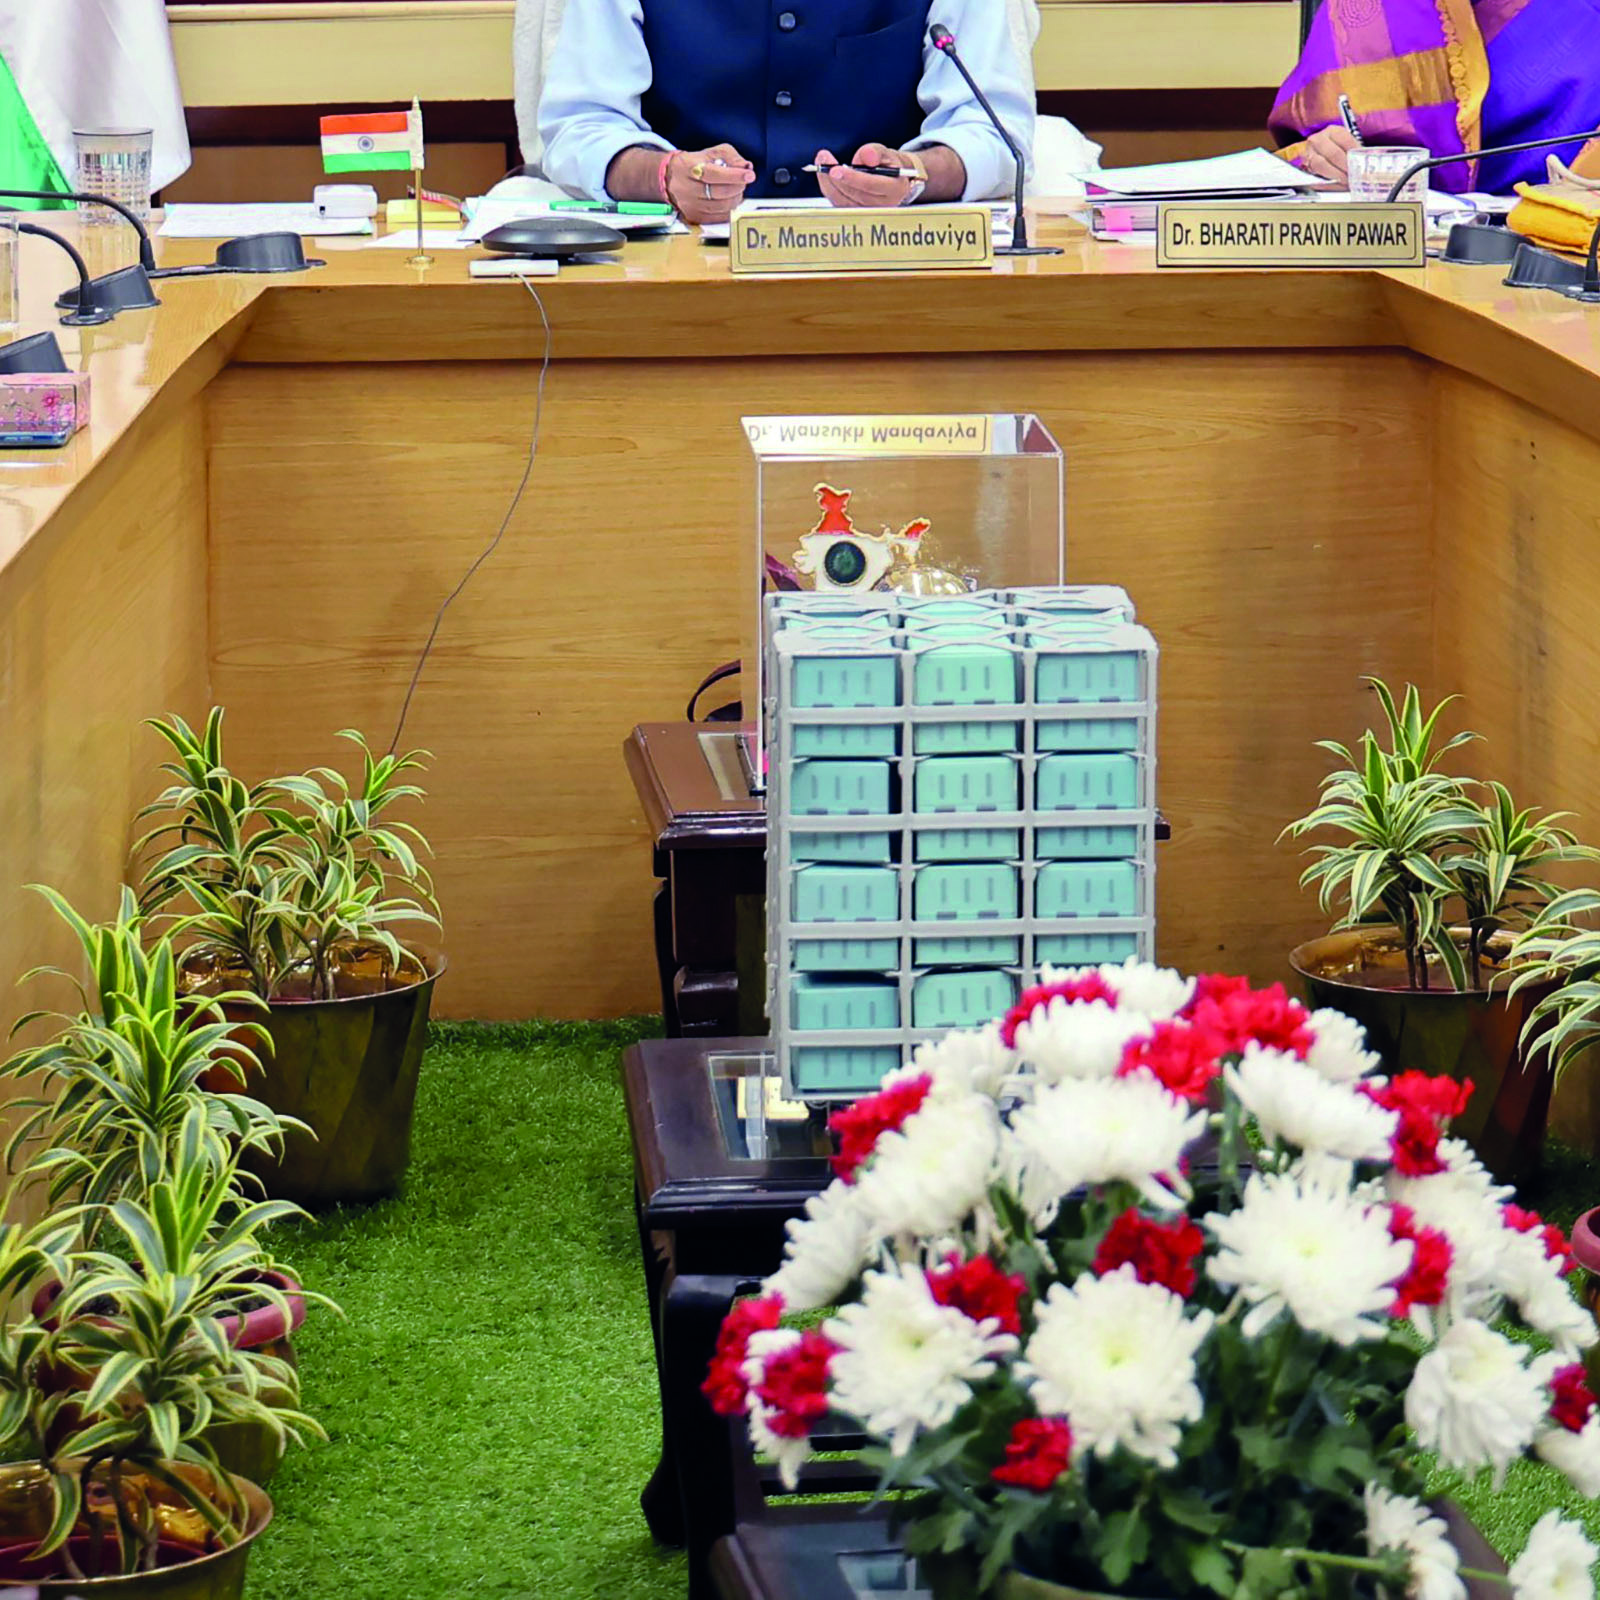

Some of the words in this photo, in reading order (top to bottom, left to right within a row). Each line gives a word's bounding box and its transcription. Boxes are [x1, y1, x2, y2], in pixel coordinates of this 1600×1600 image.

[747, 227, 772, 250] Dr.
[778, 225, 864, 249] Mansukh
[870, 223, 977, 251] Mandaviya
[1172, 222, 1194, 246] Dr.
[1200, 222, 1274, 246] BHARATI
[1279, 222, 1342, 246] PRAVIN
[1346, 222, 1408, 246] PAWAR
